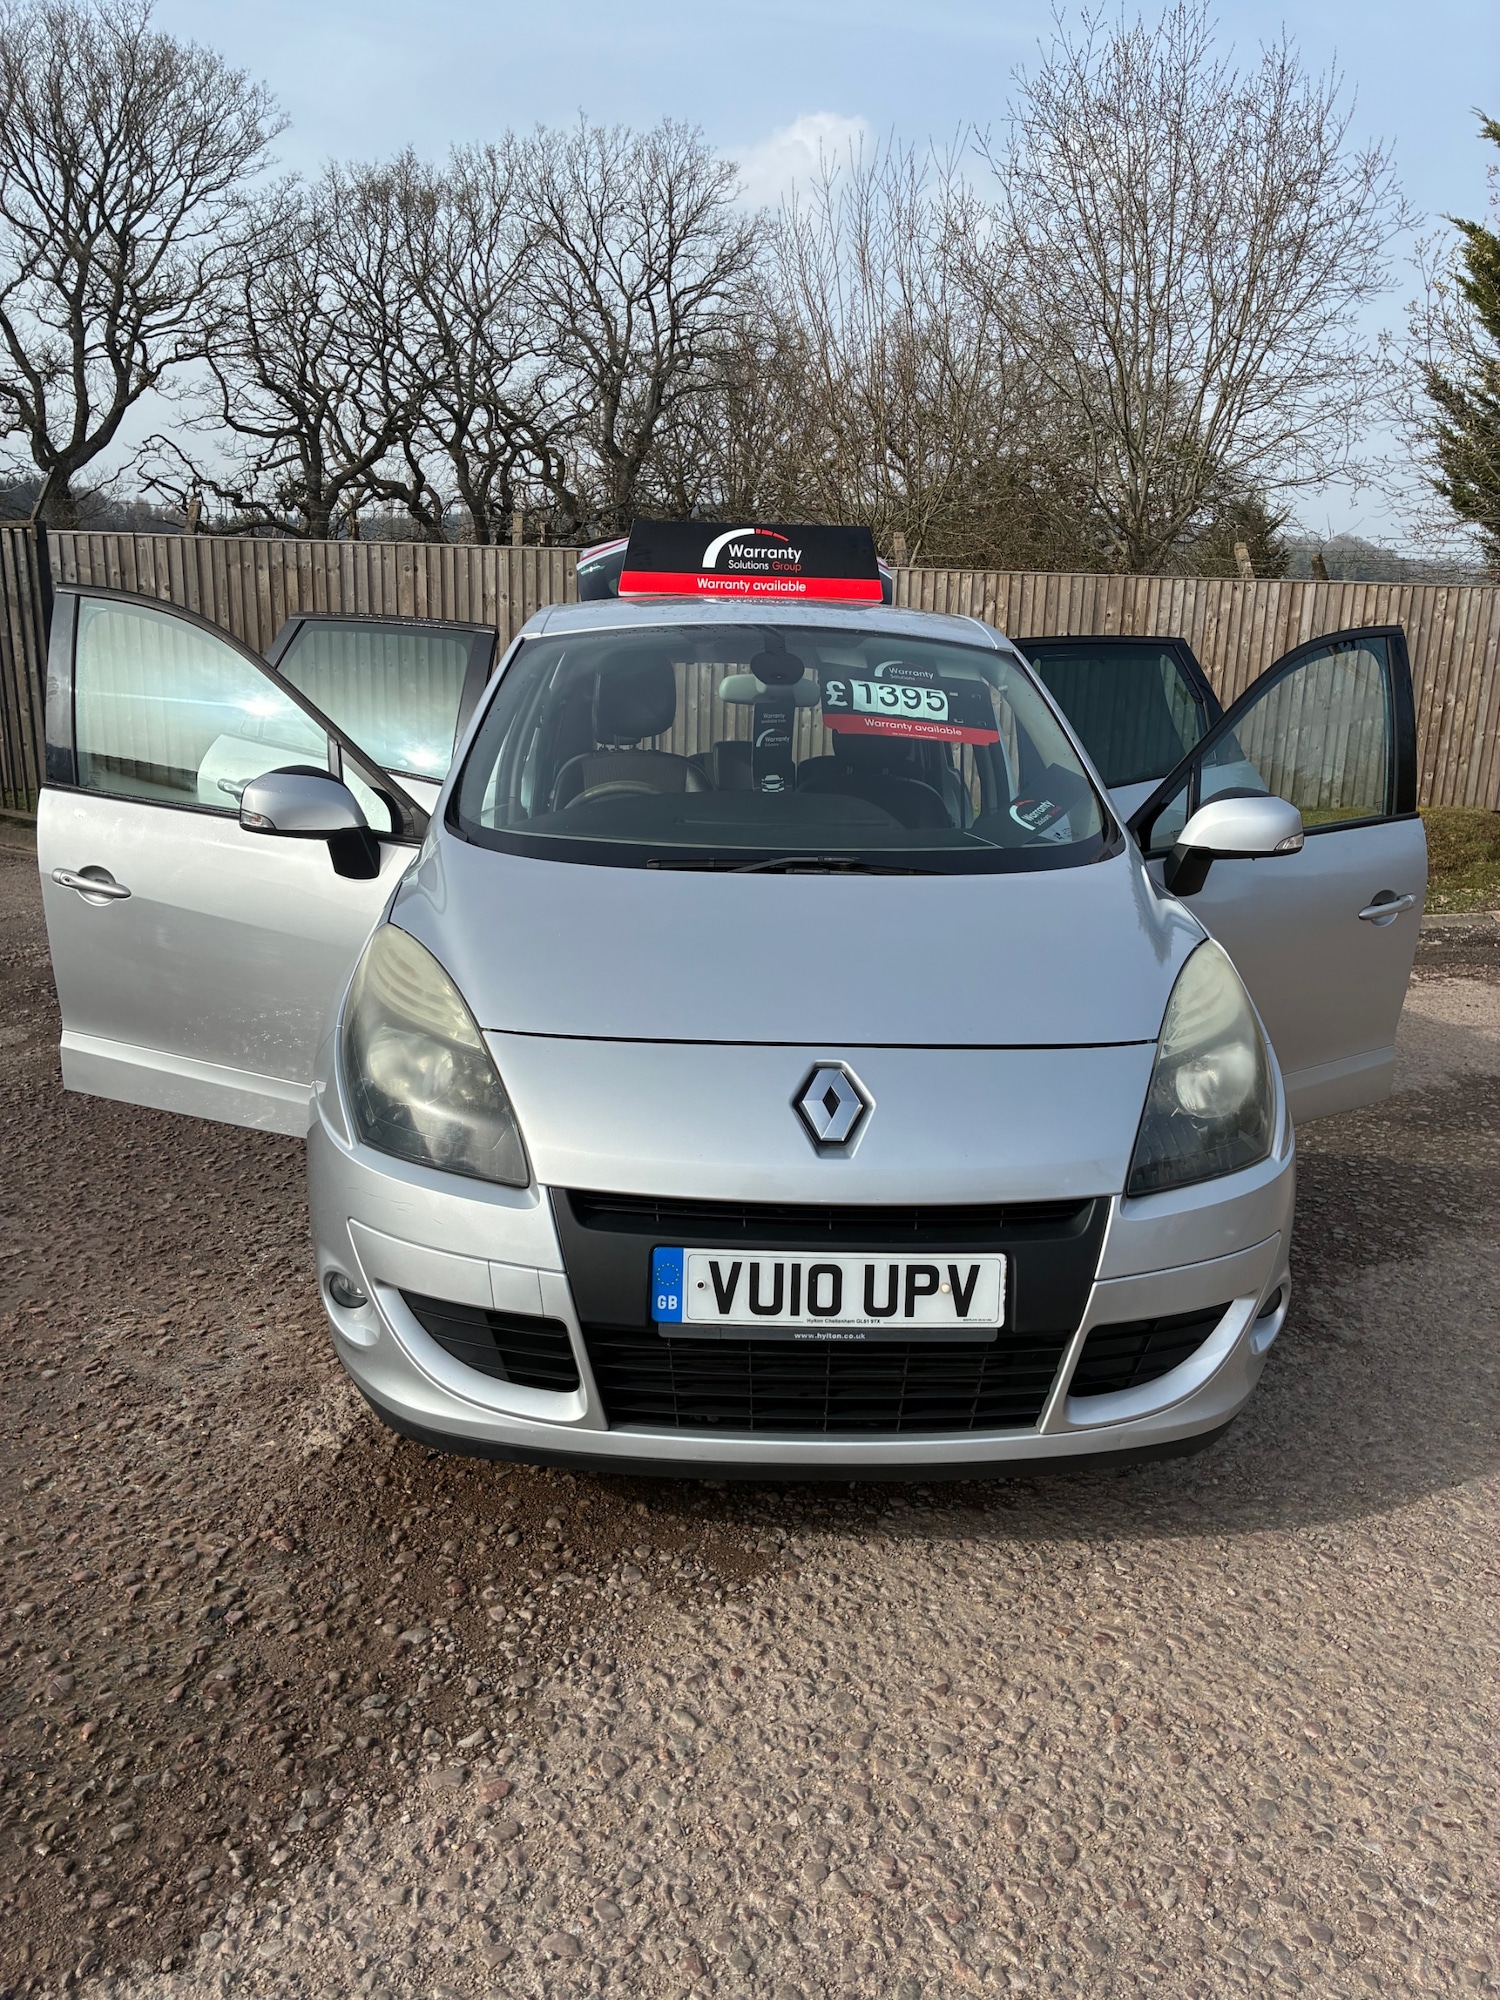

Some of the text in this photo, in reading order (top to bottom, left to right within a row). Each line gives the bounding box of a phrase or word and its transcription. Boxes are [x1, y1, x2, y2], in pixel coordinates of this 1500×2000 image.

[728, 544, 802, 563] Warranty
[728, 560, 802, 573] Solutions Group
[697, 578, 806, 592] Warranty available
[889, 667, 934, 679] Warranty
[864, 718, 913, 732] Warranty
[914, 724, 962, 736] available
[1021, 800, 1055, 822] Warranty
[863, 1264, 981, 1318] UPV
[657, 1295, 678, 1310] GB
[794, 1332, 866, 1340] www.hylton.co.uk
